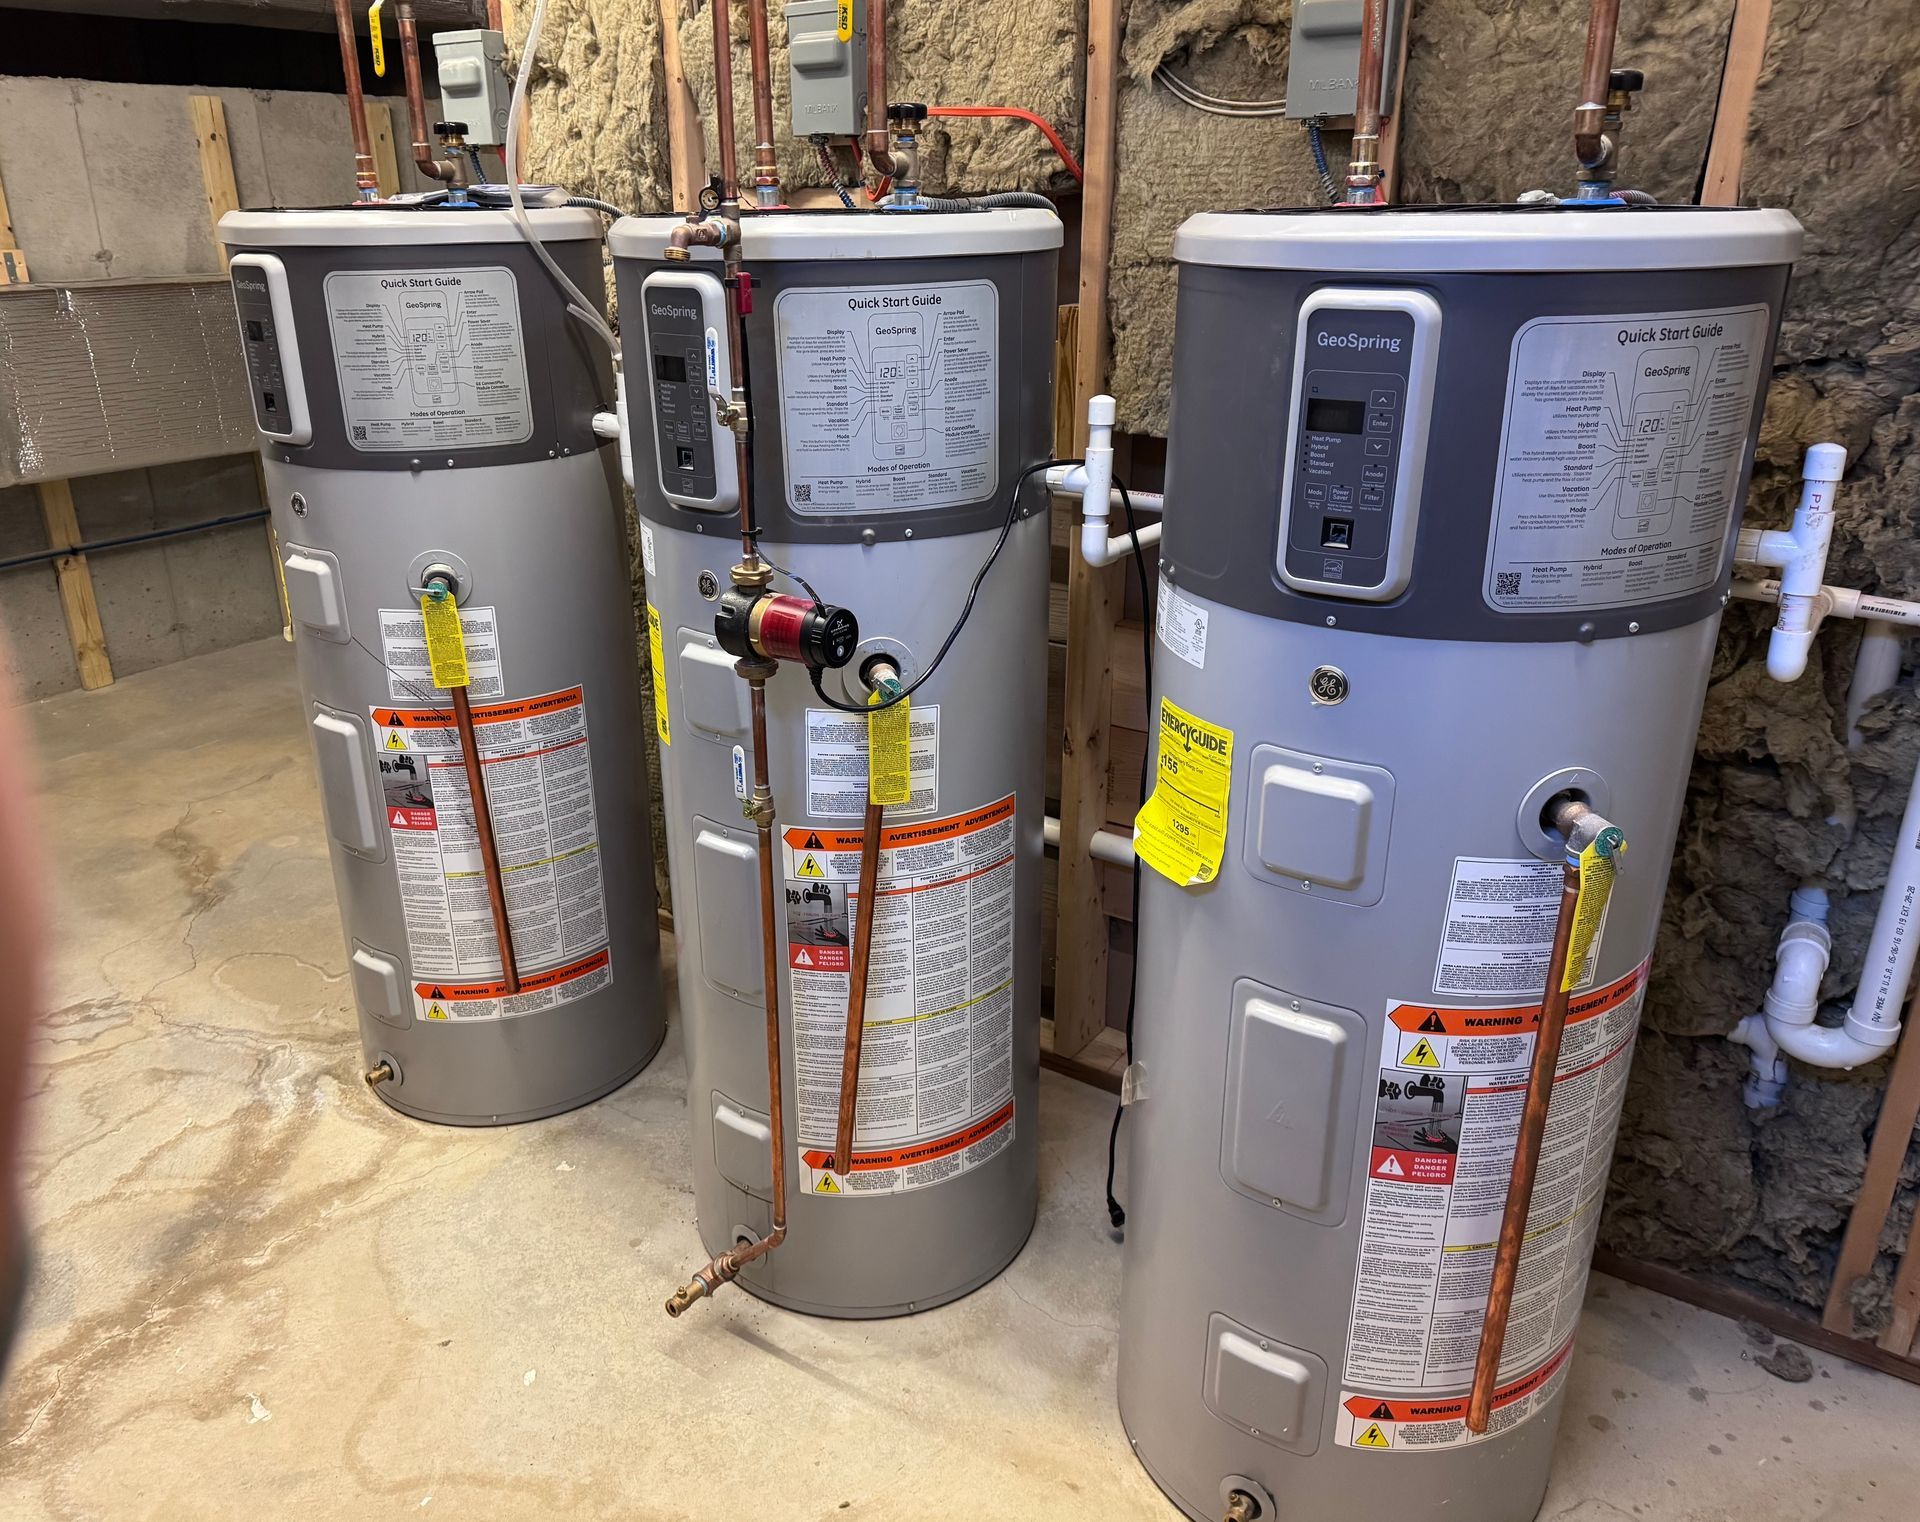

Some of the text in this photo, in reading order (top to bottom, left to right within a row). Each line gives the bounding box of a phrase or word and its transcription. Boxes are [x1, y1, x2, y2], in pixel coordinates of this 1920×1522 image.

[380, 277, 462, 289] Quick Start Guide
[406, 301, 442, 309] GeoSpring
[848, 294, 942, 311] Quick Start Guide
[651, 304, 697, 320] GeoSpring
[413, 333, 428, 342] 120
[875, 326, 917, 336] GeoSpring
[1617, 323, 1723, 346] Quick Start Guide
[1317, 332, 1401, 353] GeoSpring
[880, 367, 897, 378] 120
[1644, 365, 1691, 377] GeoSpring
[1583, 405, 1601, 413] Pump
[1372, 419, 1389, 427] Enter
[1639, 419, 1660, 433] 120
[867, 465, 889, 473] Modes
[898, 462, 931, 471] Operation
[1310, 460, 1334, 468] Standard
[1601, 541, 1672, 556] Modes of Operation
[471, 706, 524, 719] ERTISSEMENT
[529, 694, 577, 711] ADVERTENCIA
[1161, 706, 1228, 756] ENERGYGUIDE
[836, 804, 1010, 844] WARN AVERTISSEMENT ADVERTENCIA
[1172, 818, 1190, 836] 1295
[1888, 937, 1902, 964] 05/06/16
[453, 988, 489, 996] WARNING
[559, 957, 603, 978] ADVERTENCIA
[1880, 986, 1888, 995] IN
[1875, 996, 1886, 1011] MADE
[1464, 1016, 1523, 1027] WARNING
[851, 1111, 1009, 1165] WARNING AVERTISSEMENT ADVERTENCIA
[1410, 1404, 1462, 1415] WARNING
